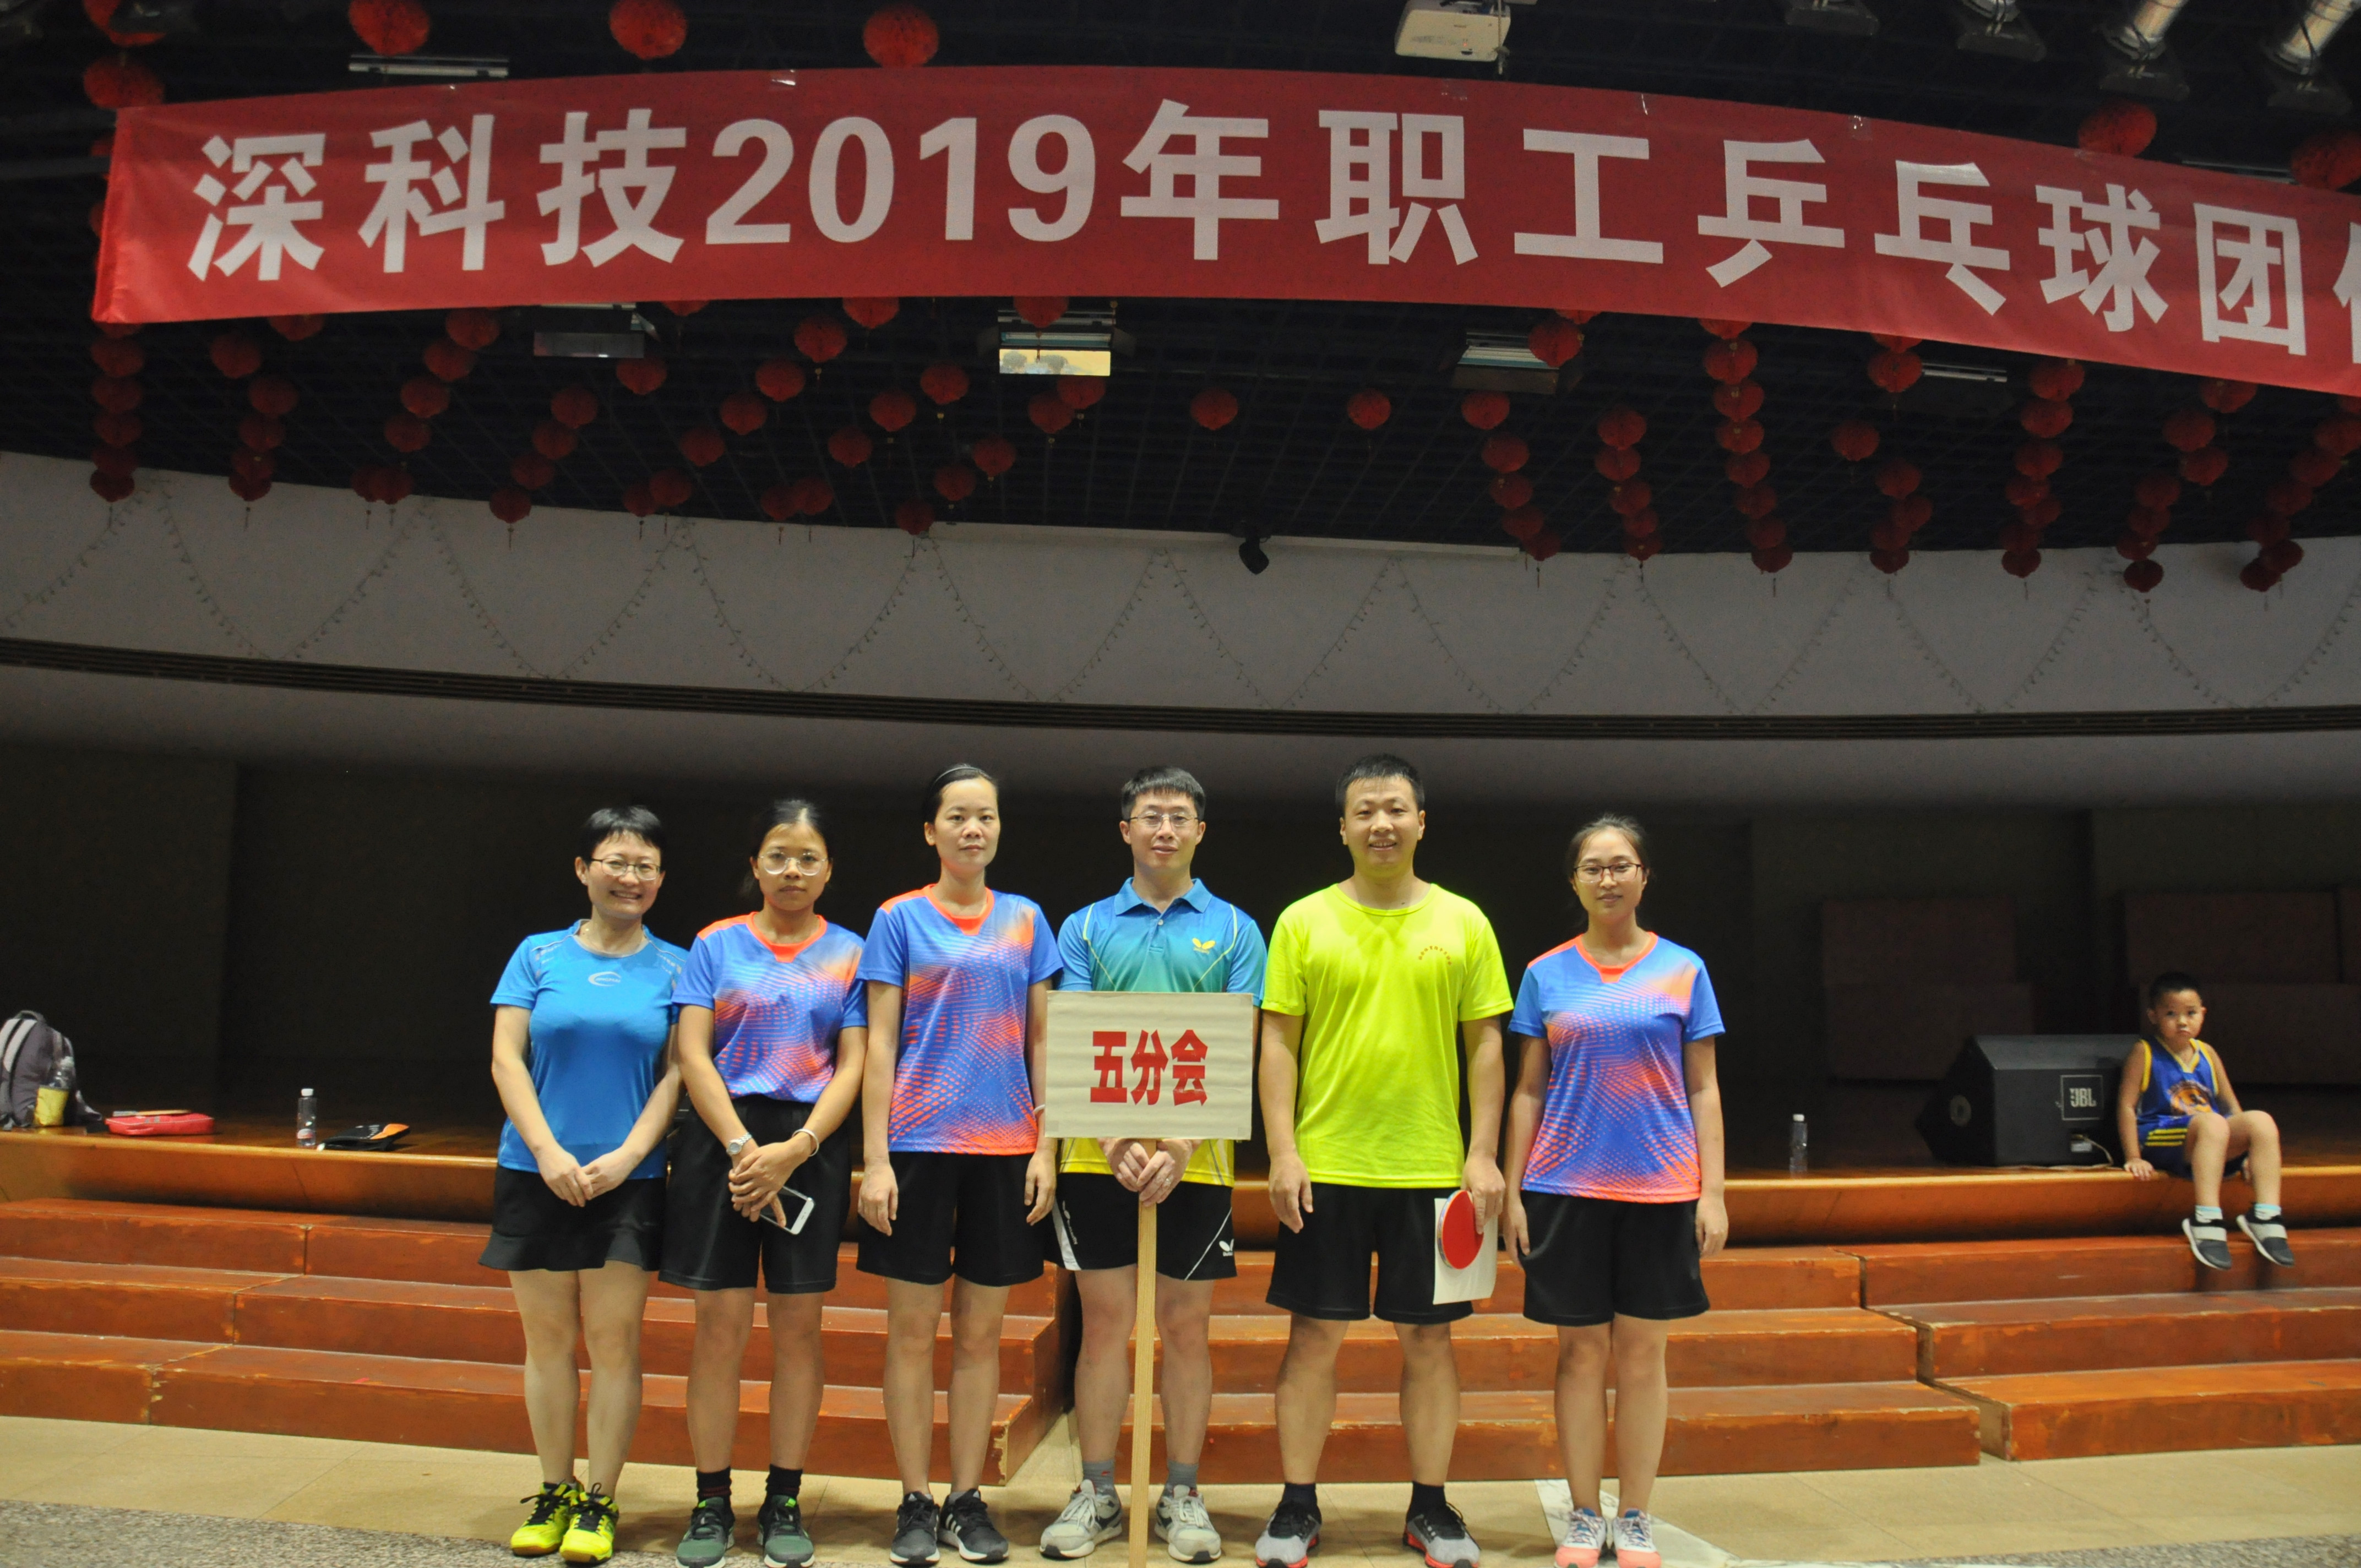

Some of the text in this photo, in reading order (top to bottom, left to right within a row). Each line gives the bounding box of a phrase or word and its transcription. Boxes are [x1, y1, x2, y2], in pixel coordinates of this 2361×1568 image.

[188, 99, 2361, 364] 深科技2019年职工乒乓球团
[1090, 1029, 1208, 1106] 五分会
[2069, 1087, 2097, 1107] JBL
